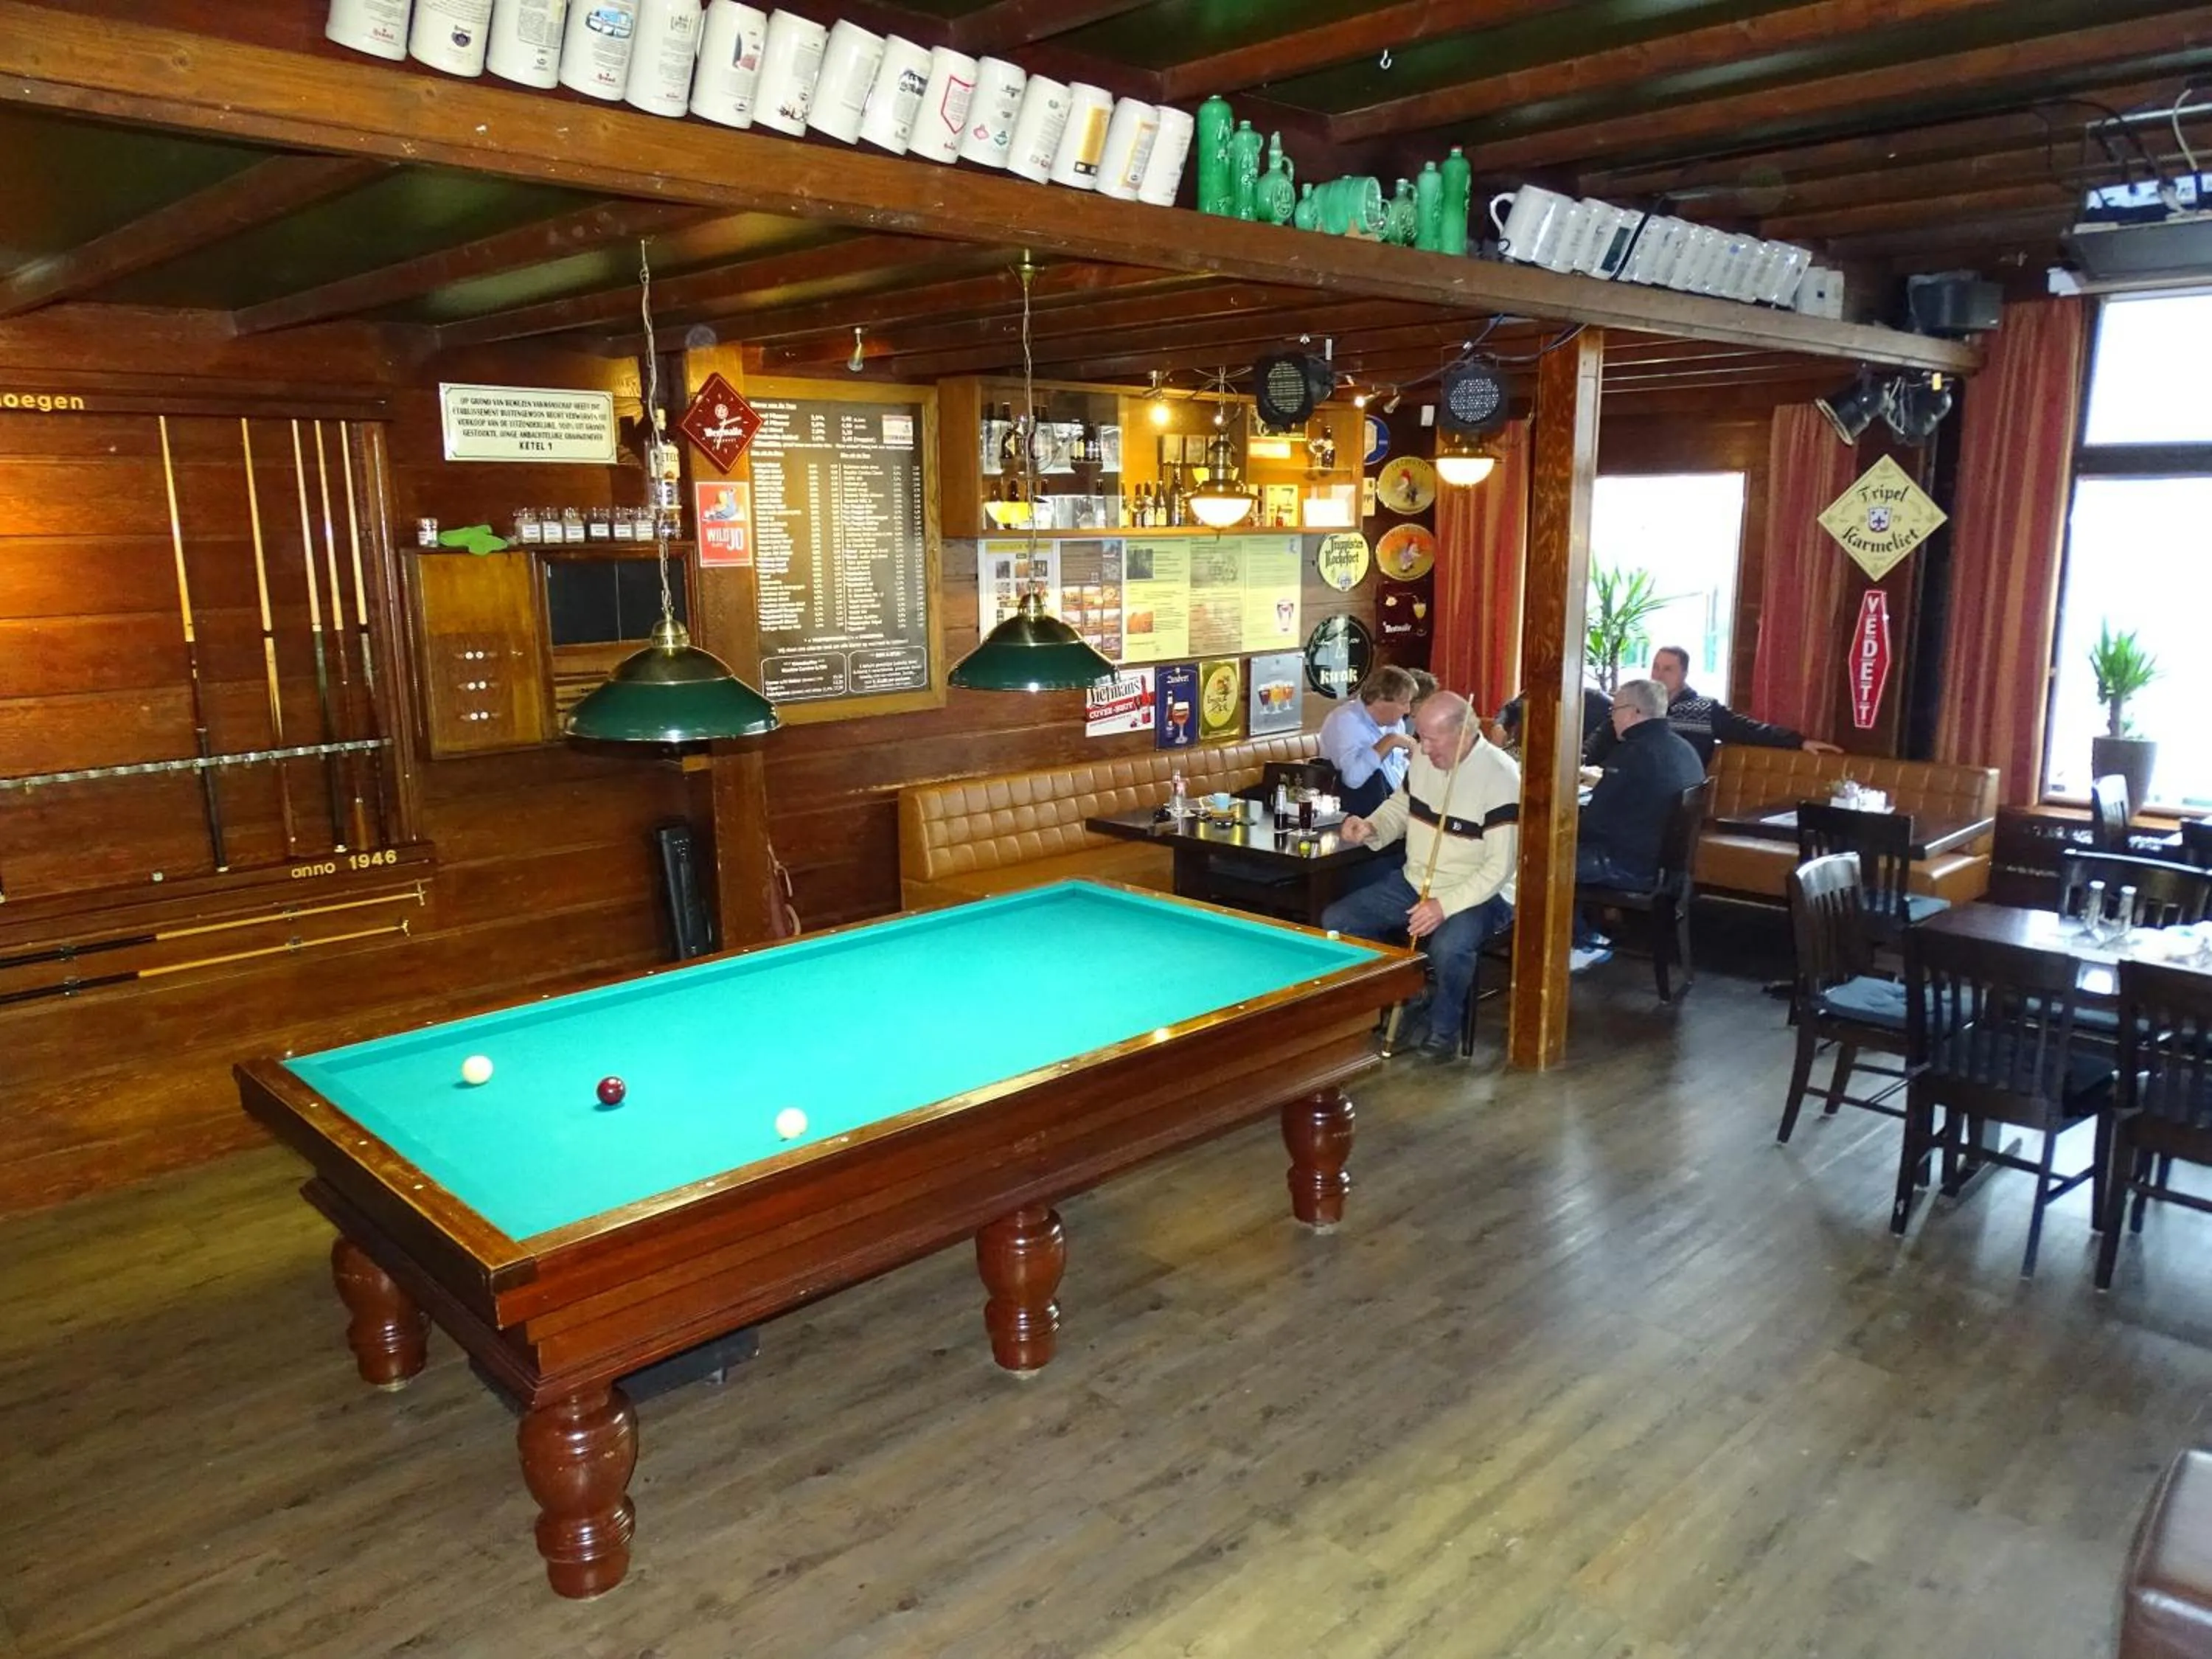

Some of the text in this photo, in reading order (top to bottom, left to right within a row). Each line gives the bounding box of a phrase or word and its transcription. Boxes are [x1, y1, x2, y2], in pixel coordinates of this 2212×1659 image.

[0, 393, 85, 411] oegen
[519, 442, 545, 451] KETEL
[1857, 482, 1910, 504] Tripel
[726, 527, 744, 551] JO
[1841, 525, 1920, 553] Karmeliet
[1859, 596, 1879, 721] VEDETT
[291, 849, 397, 878] anno 1946
